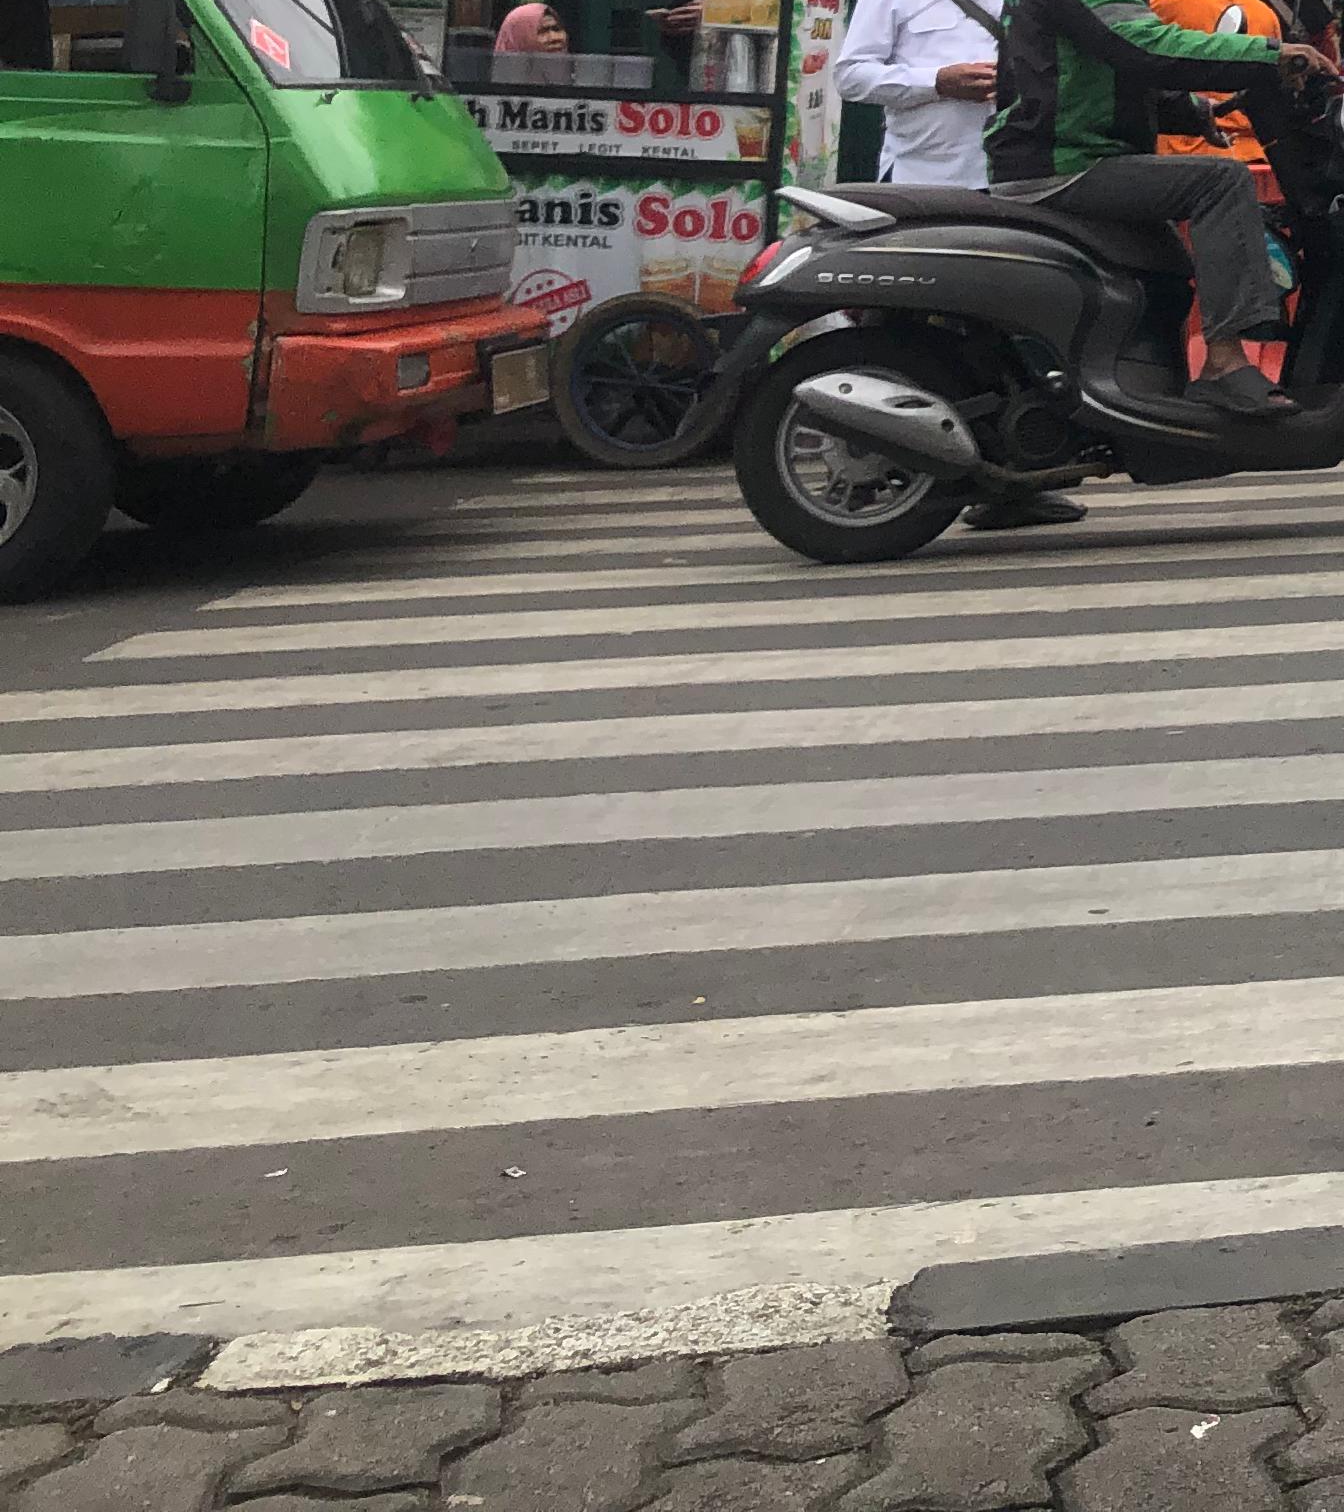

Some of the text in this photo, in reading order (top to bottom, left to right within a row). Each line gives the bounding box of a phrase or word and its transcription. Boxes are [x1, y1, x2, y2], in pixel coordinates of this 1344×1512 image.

[499, 99, 608, 133] Manis
[616, 100, 723, 138] Solo
[511, 140, 699, 159] SEPET LEGIT KENTAL
[516, 191, 762, 242] anis Solo
[542, 233, 613, 249] KENTAL
